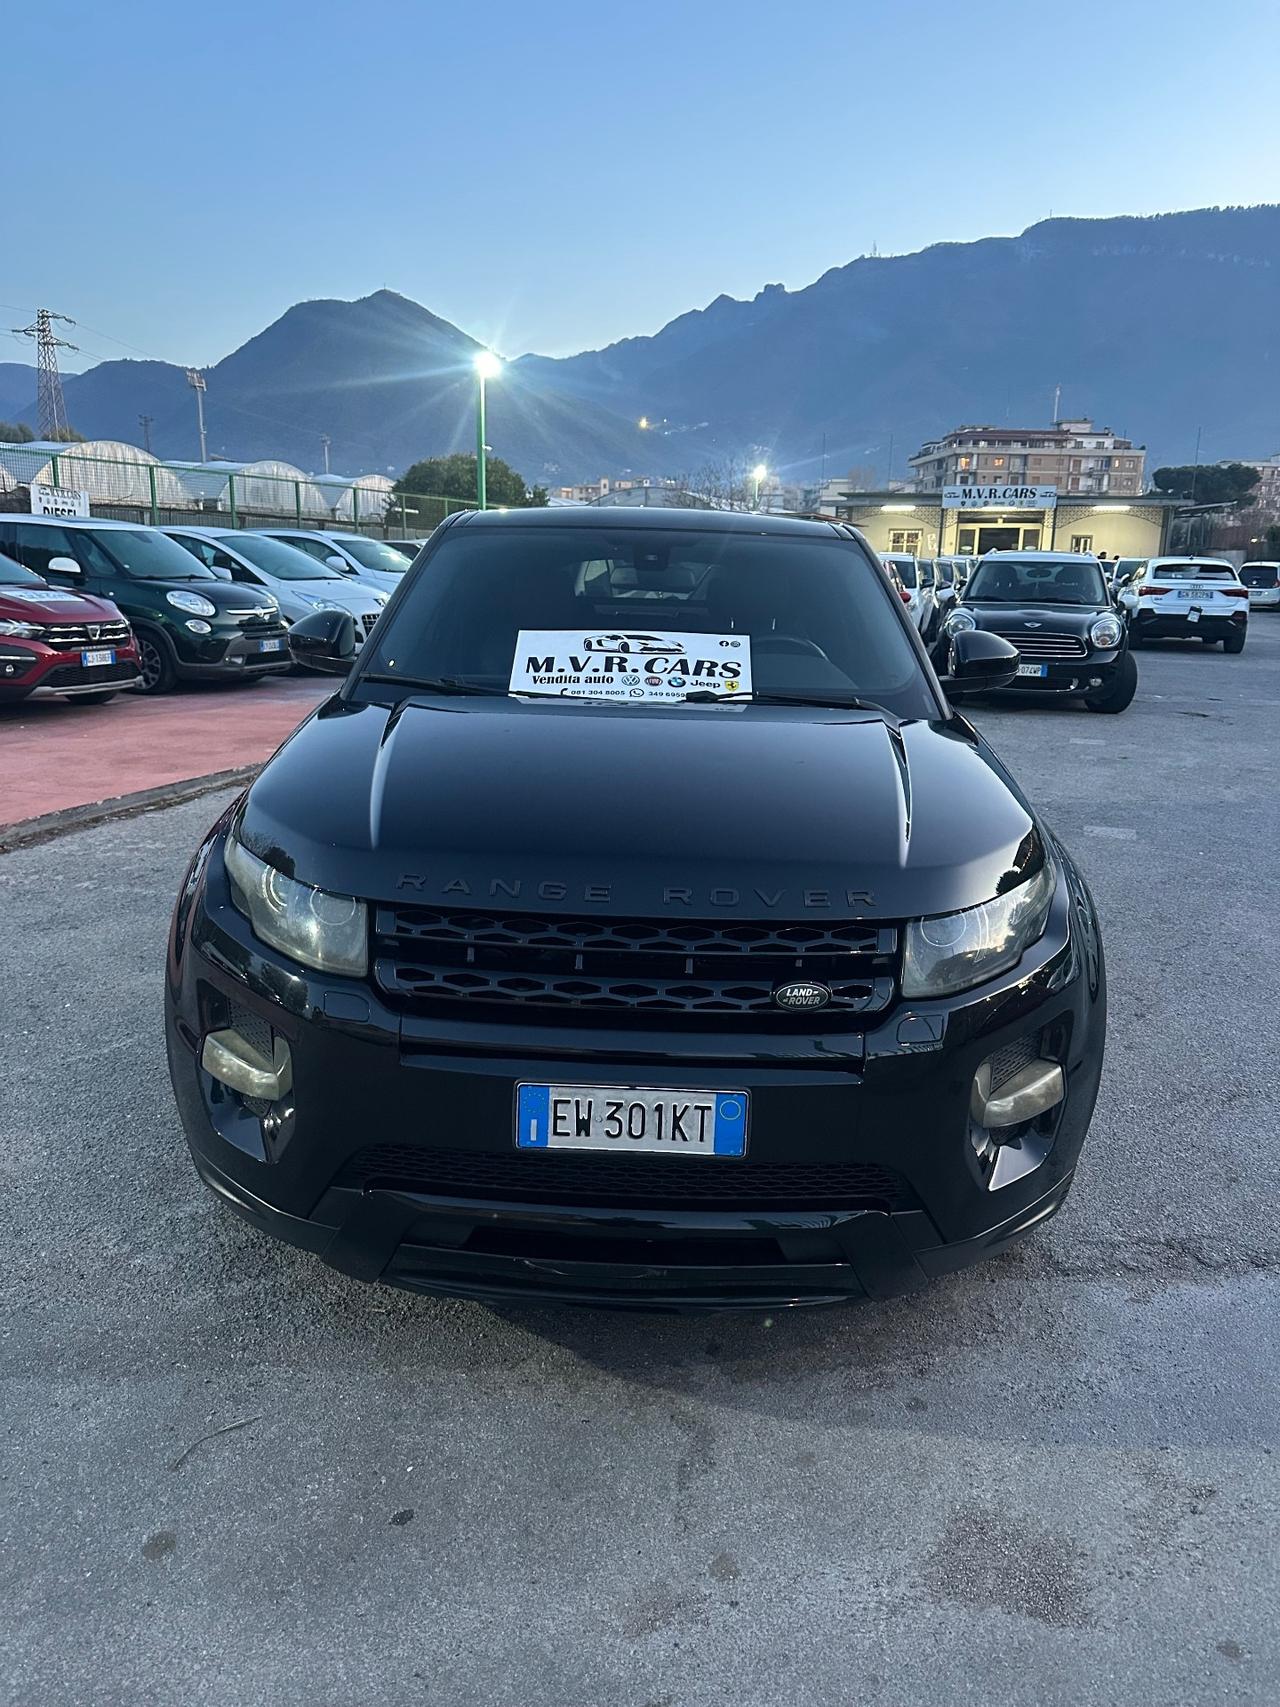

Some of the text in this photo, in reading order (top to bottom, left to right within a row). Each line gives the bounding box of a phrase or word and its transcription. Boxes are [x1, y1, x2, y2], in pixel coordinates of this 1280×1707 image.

[961, 487, 1037, 499] M.V.R.CARS
[526, 655, 742, 679] M.V.R.CARS
[532, 675, 614, 685] Vendita auto
[690, 680, 720, 688] Jeep
[394, 873, 878, 908] RANGE ROVER
[552, 1099, 712, 1142] EW 301KT
